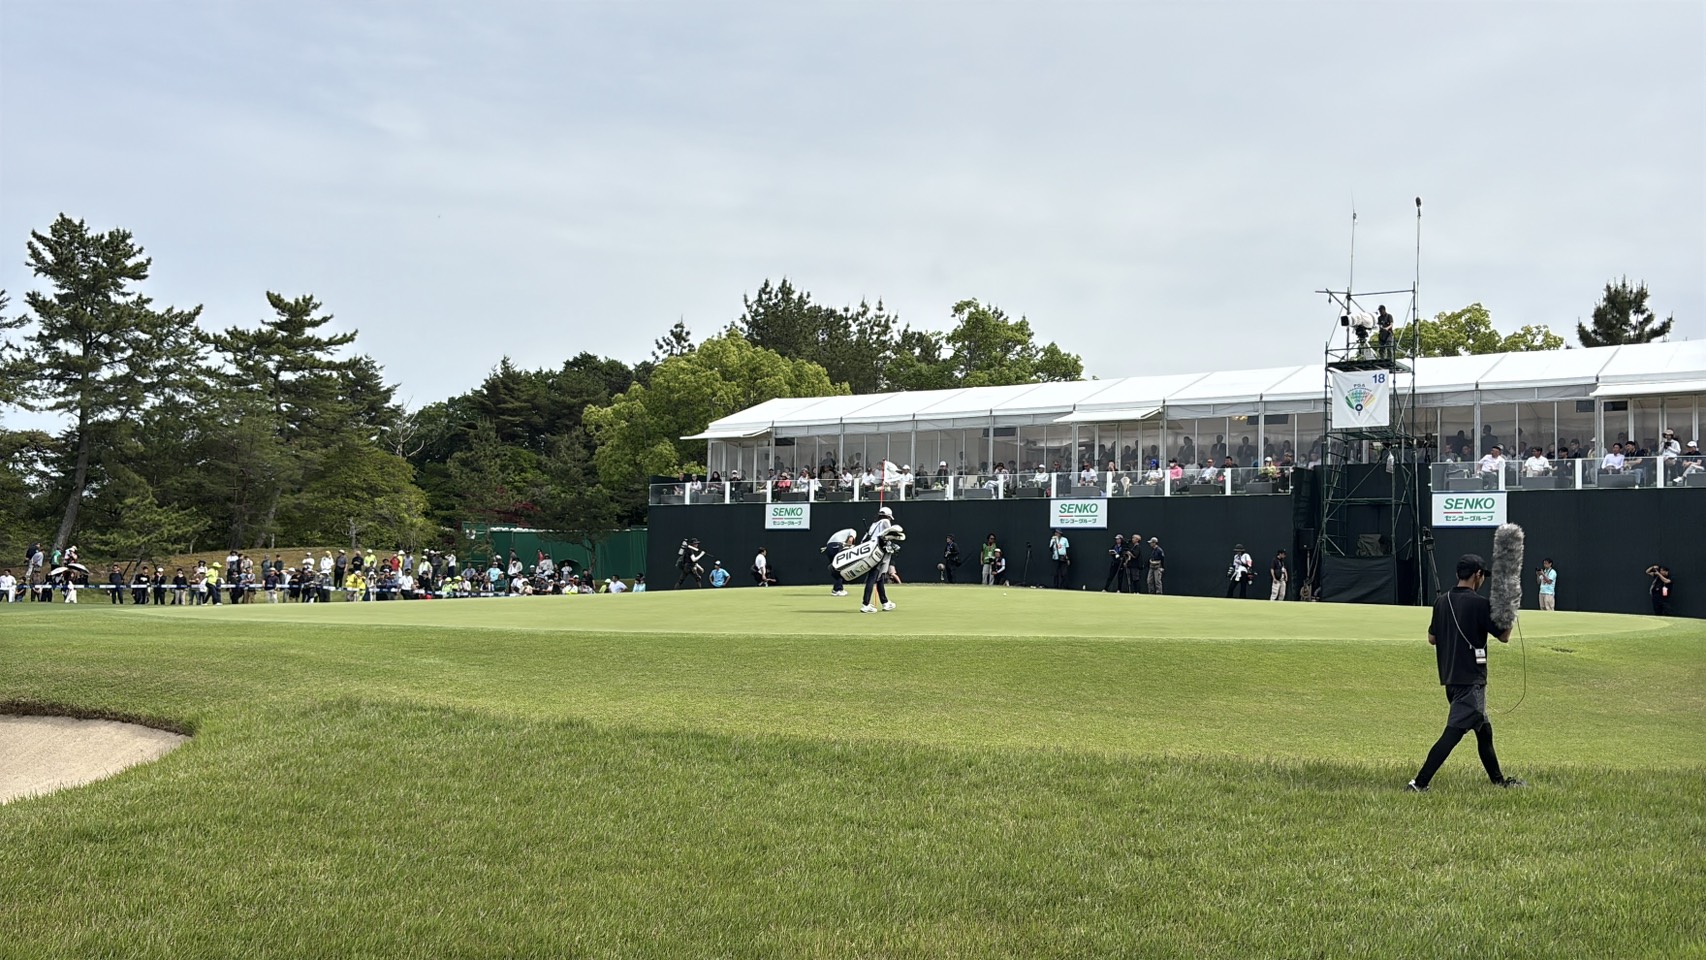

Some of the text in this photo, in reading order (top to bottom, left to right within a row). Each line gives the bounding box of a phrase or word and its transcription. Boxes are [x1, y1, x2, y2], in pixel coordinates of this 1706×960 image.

[1372, 373, 1385, 383] 18
[1059, 503, 1098, 514] SENKO
[1443, 497, 1495, 510] SENKO
[772, 507, 803, 516] SENKO
[836, 544, 870, 564] PING
